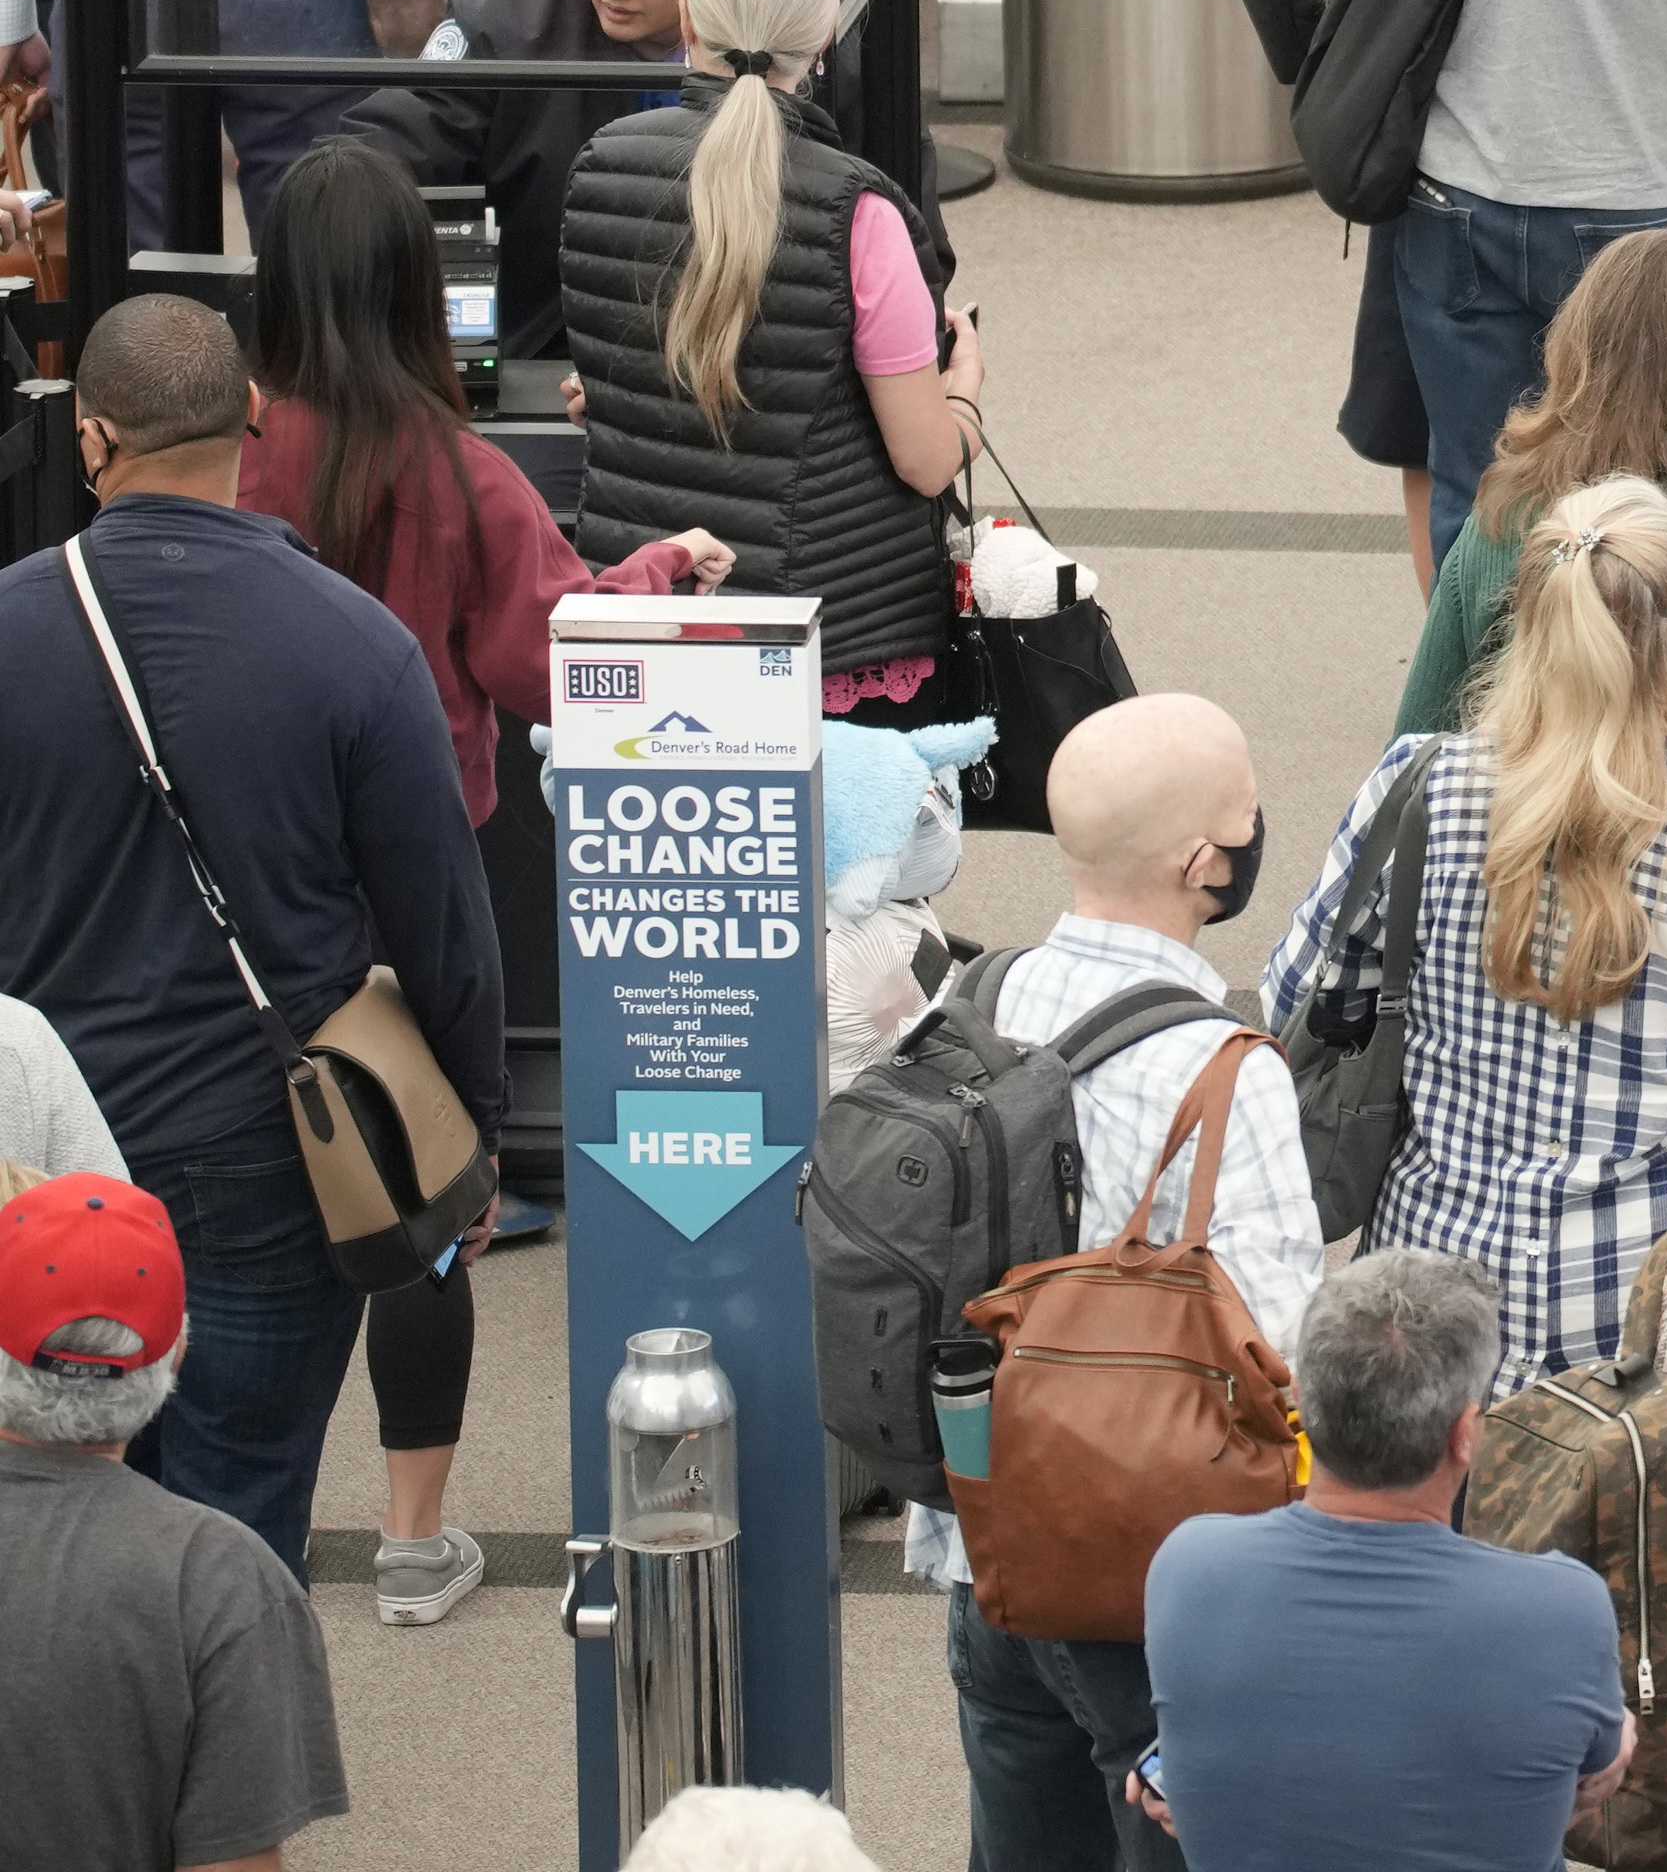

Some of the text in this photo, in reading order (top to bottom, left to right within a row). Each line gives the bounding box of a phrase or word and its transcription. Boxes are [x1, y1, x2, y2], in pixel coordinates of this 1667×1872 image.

[434, 227, 459, 235] ENTA
[760, 665, 793, 676] DEN
[580, 666, 628, 697] USO
[651, 740, 797, 755] Denver's Road Home
[568, 785, 796, 832] LOOSE
[567, 835, 798, 876] CHANGE
[568, 888, 799, 913] CHANGES THE
[569, 916, 801, 960] WORLD
[668, 970, 704, 985] Help
[613, 986, 760, 1001] Denver's Homeless,
[619, 1001, 754, 1017] Travelers in Need,
[673, 1017, 702, 1030] and
[626, 1033, 749, 1049] Military Families
[649, 1049, 726, 1063] With Your
[635, 1066, 742, 1081] Loose Change
[628, 1131, 752, 1166] HERE
